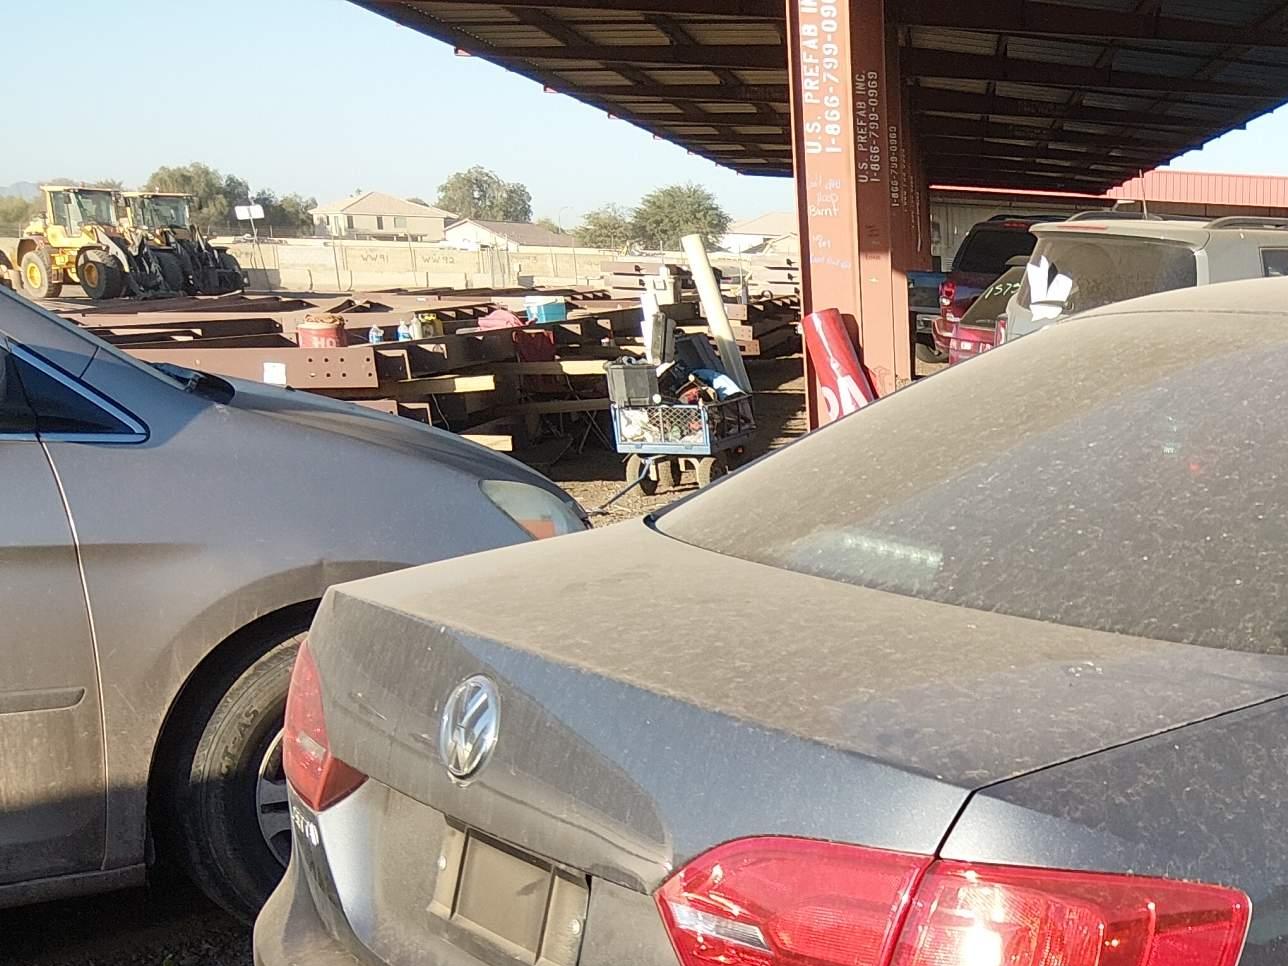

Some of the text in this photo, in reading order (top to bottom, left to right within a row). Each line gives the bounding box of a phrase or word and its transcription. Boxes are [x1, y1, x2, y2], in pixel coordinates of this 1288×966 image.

[802, 23, 820, 104] PREFAB
[805, 116, 822, 154] U.S.
[855, 70, 869, 183] U.S. PREFAB INC.
[867, 71, 880, 182] 1-866-799-0969
